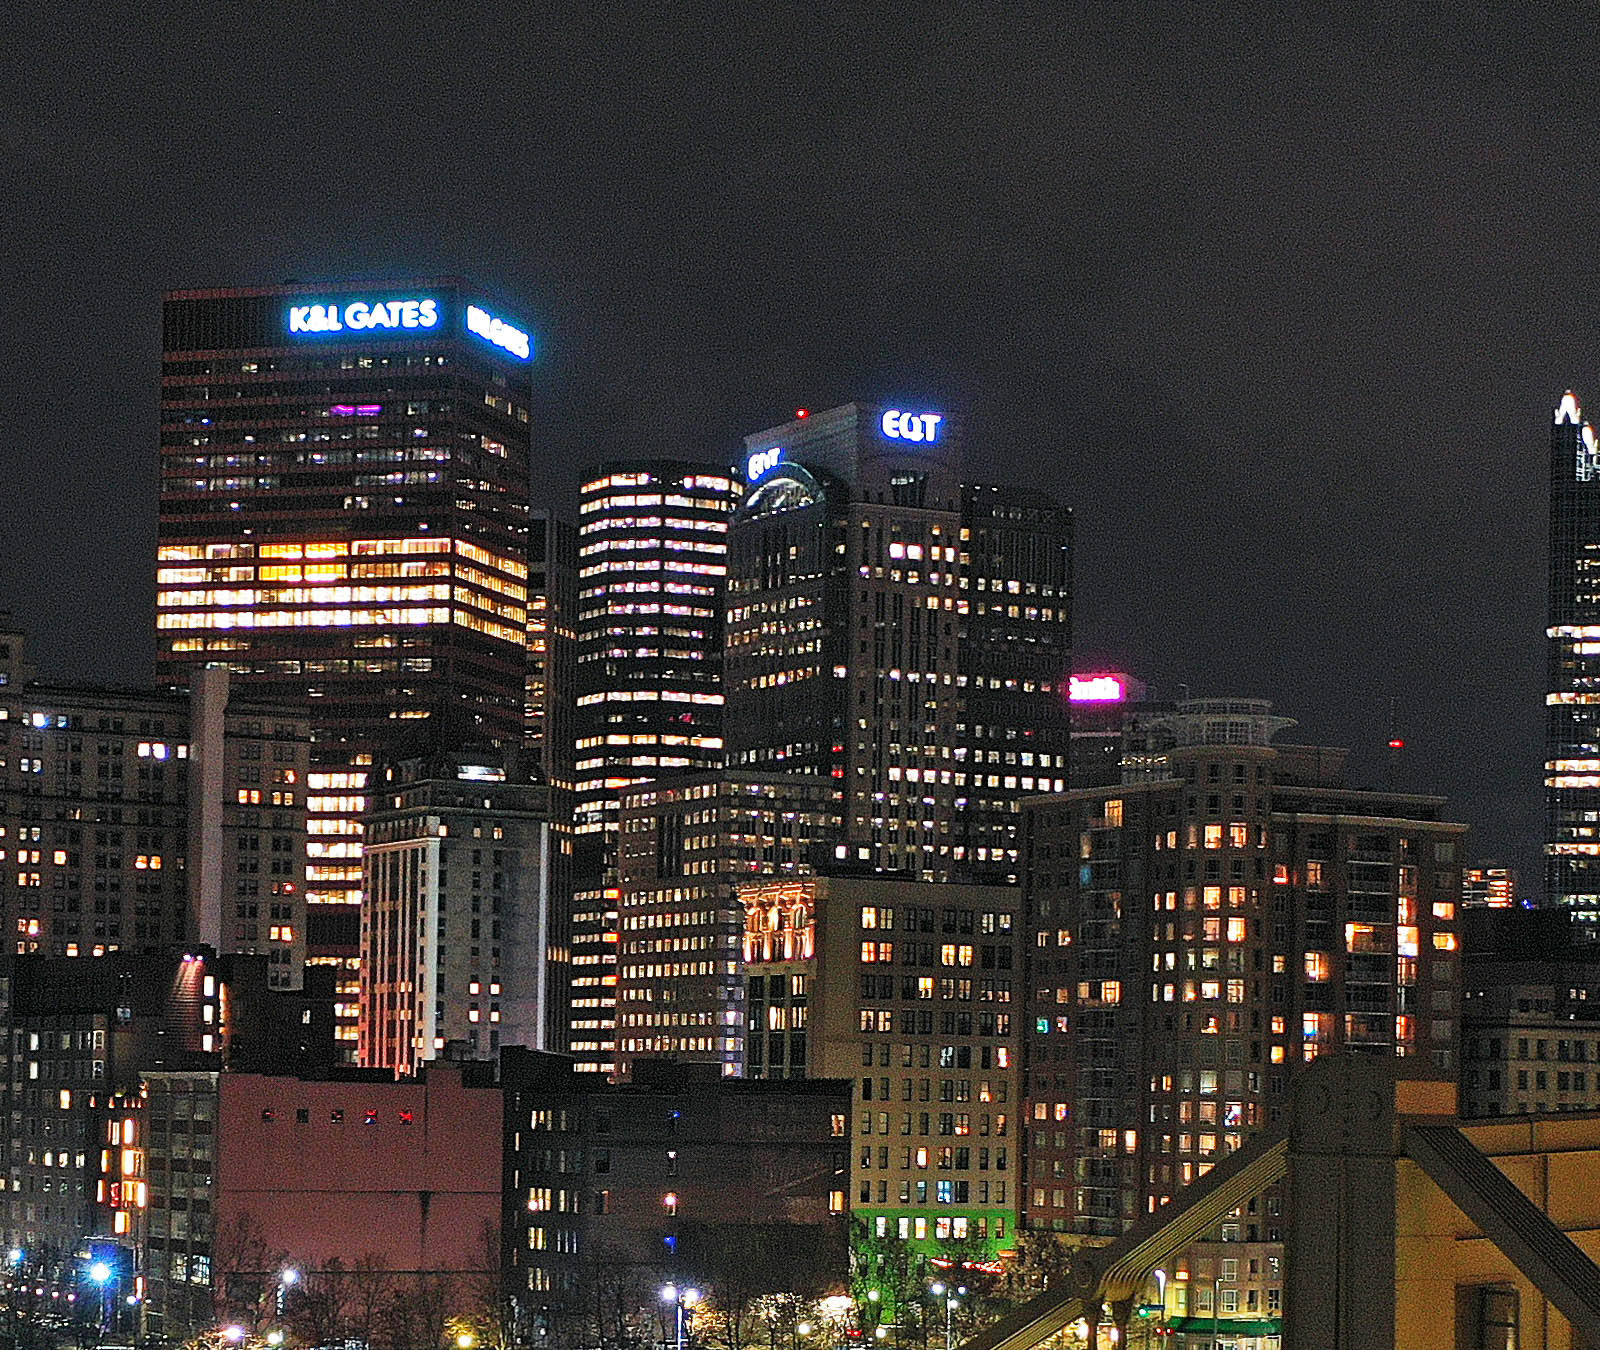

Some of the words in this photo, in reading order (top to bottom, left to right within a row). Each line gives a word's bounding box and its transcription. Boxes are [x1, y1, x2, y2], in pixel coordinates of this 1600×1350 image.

[290, 304, 342, 333] K&L
[344, 299, 437, 330] GATES
[882, 410, 941, 442] EQT
